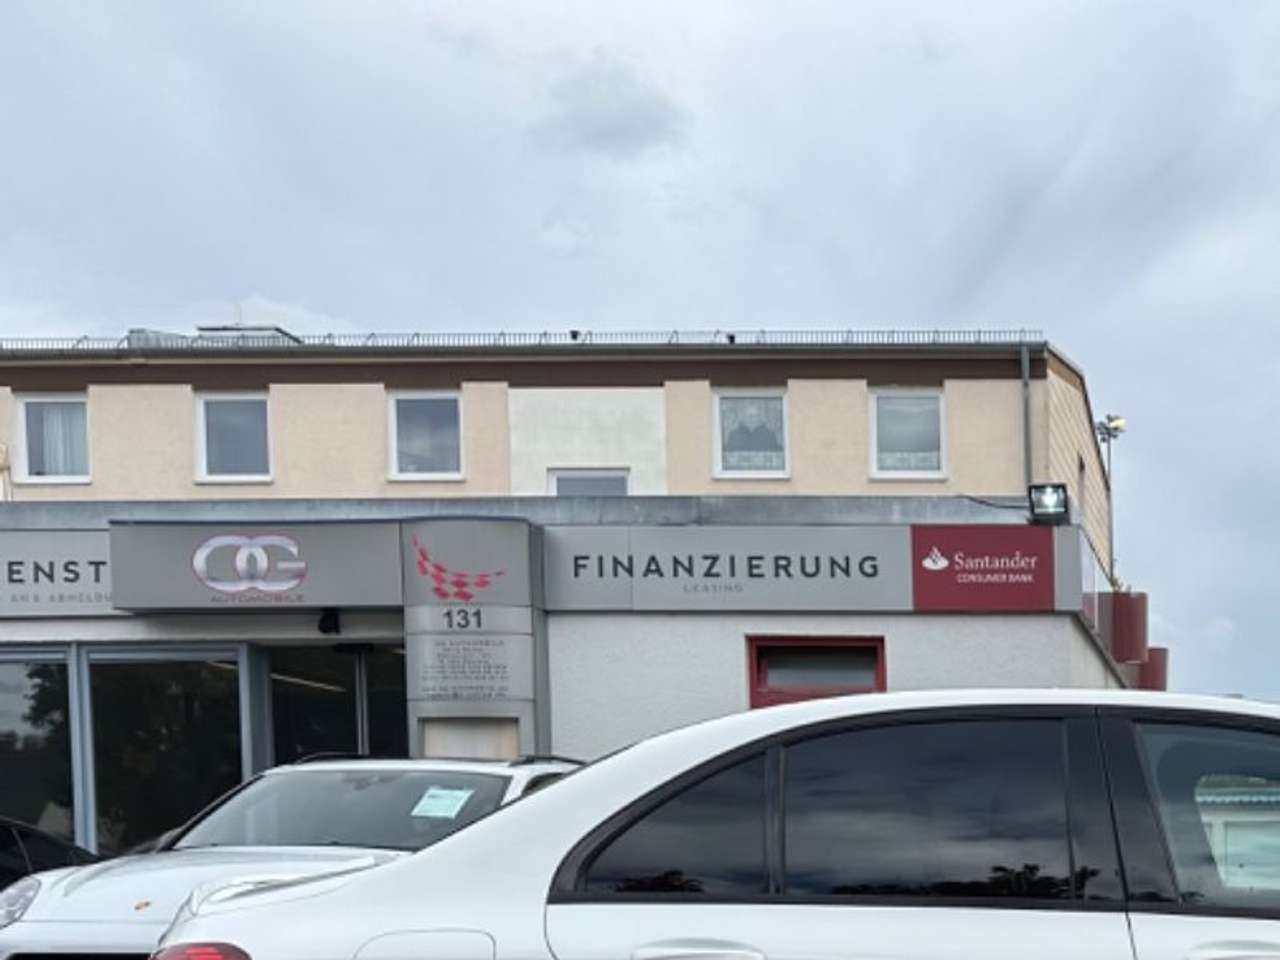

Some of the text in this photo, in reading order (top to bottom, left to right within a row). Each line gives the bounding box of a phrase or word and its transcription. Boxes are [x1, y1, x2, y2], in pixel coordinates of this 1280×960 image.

[7, 560, 108, 583] ENST
[572, 554, 880, 579] FINANZIERUNG
[953, 551, 1038, 571] Santander
[443, 608, 482, 629] 131
